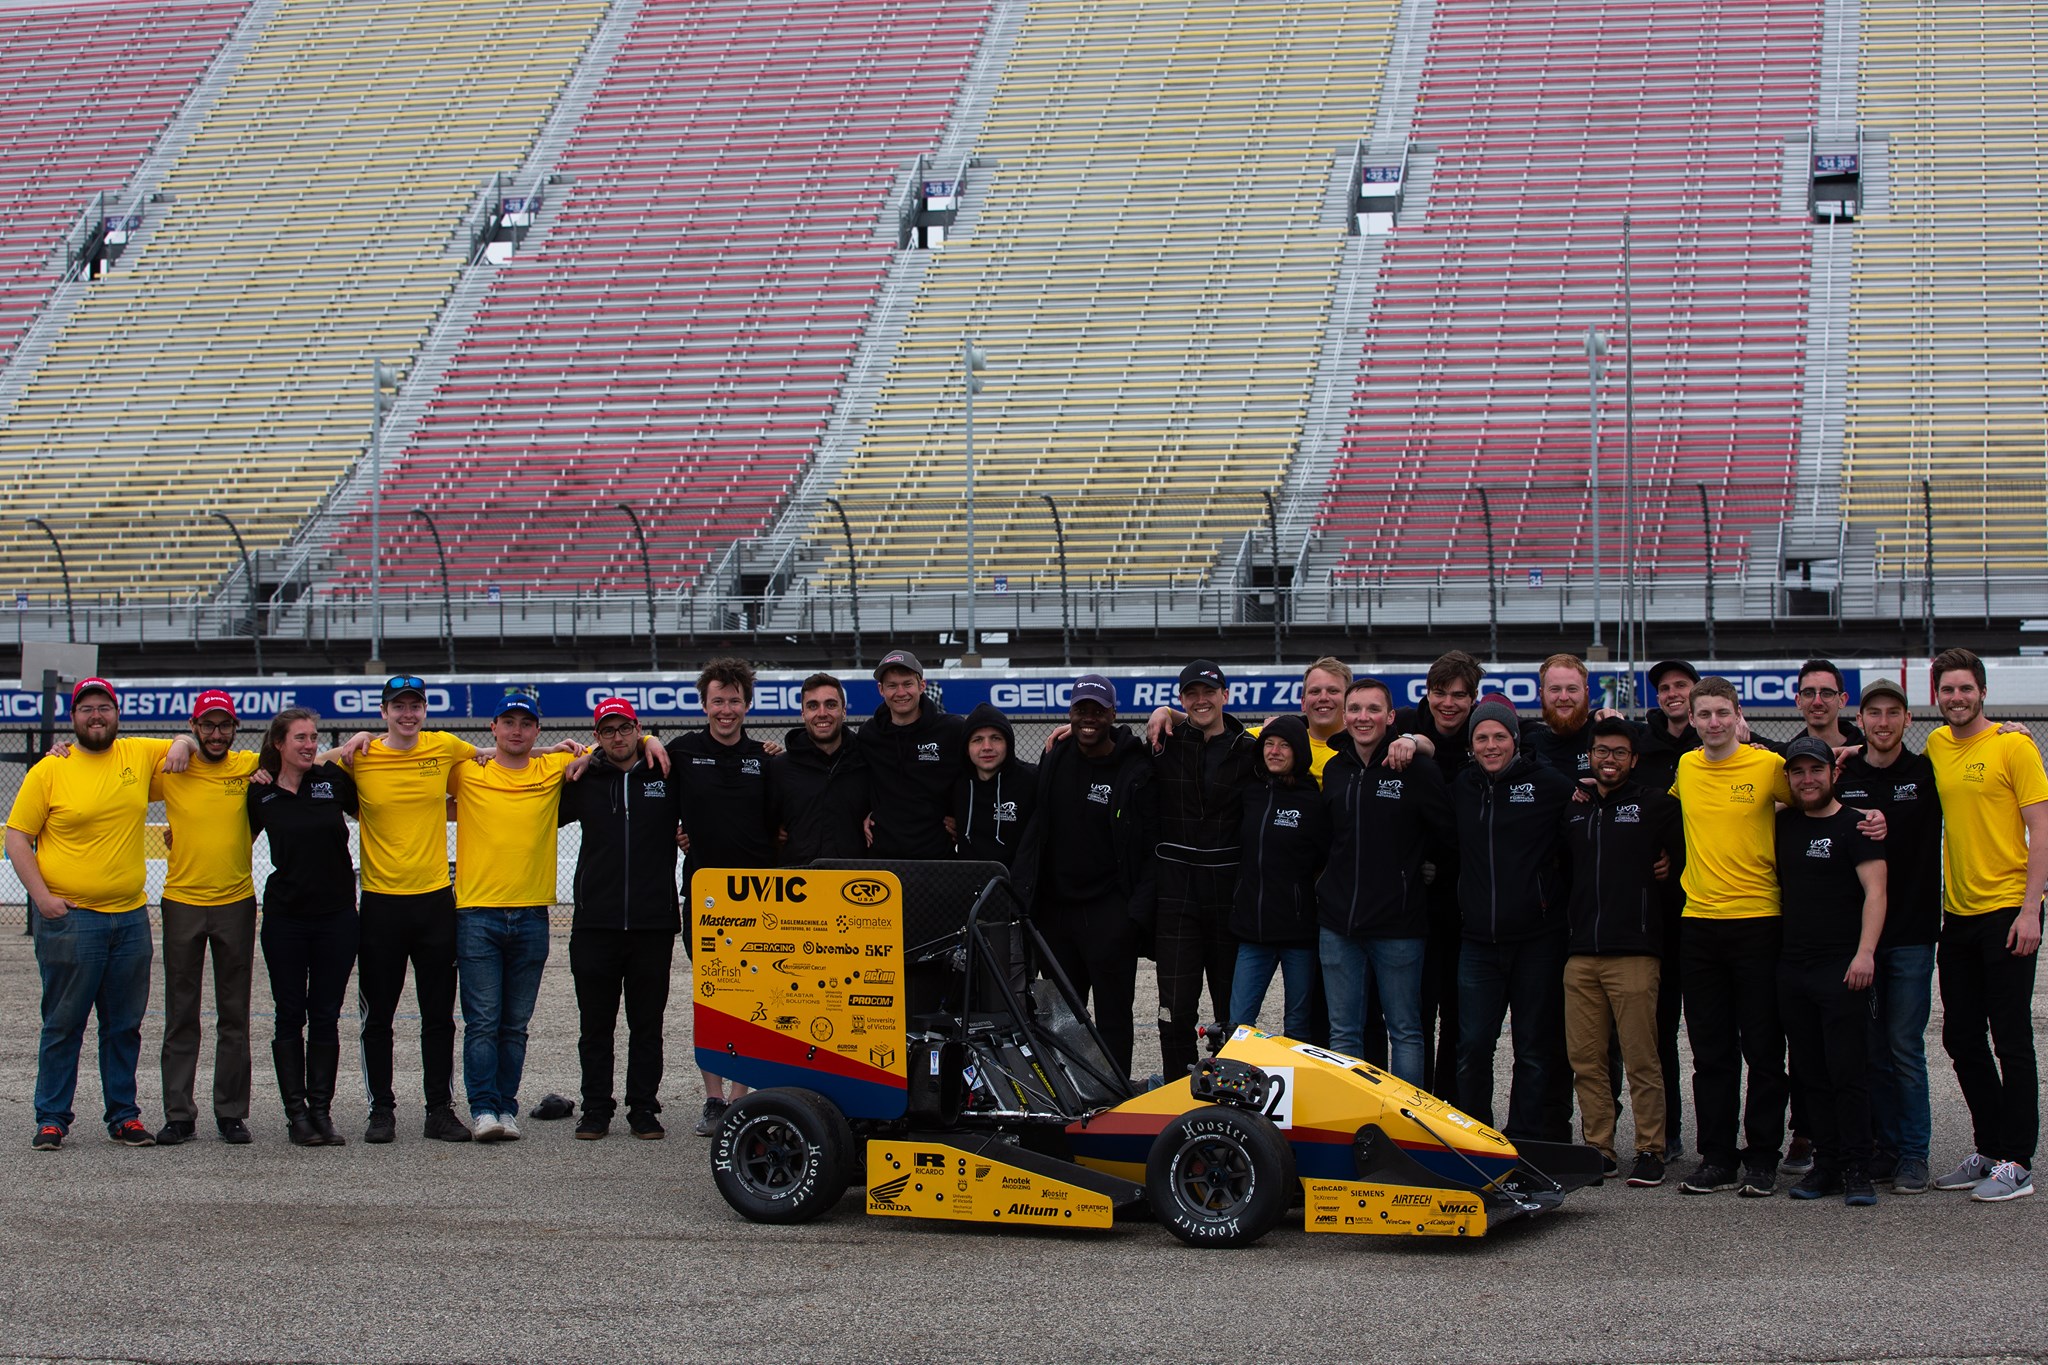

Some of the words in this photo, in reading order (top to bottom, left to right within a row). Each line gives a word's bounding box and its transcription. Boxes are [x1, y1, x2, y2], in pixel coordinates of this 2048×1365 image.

[1370, 171, 1382, 179] 32
[1385, 171, 1398, 179] 34
[930, 186, 941, 194] 30
[995, 583, 1006, 591] 32
[1529, 576, 1540, 586] 34
[1077, 682, 1107, 691] Champion
[1407, 678, 1537, 703] GCO
[333, 688, 451, 713] GEO
[990, 683, 1075, 708] GEIC
[728, 876, 808, 903] UVIC
[851, 884, 880, 897] CRP
[699, 914, 757, 927] Mastercam
[848, 915, 892, 928] sigmatex
[816, 942, 859, 955] brembo
[865, 945, 893, 957] SKF
[701, 964, 741, 976] StarFish
[865, 968, 895, 982] action
[852, 996, 890, 1005] PROCOM
[1265, 1074, 1285, 1121] 2
[1182, 1120, 1248, 1142] Hoosier
[715, 1109, 746, 1172] Hoosier
[792, 1142, 822, 1207] Hoosier
[1002, 1176, 1030, 1184] Anotek
[1041, 1189, 1068, 1198] Hoosier
[1501, 1183, 1519, 1191] CRP
[1392, 1194, 1432, 1204] AIRTECH
[870, 1203, 912, 1212] HONDA
[1008, 1203, 1058, 1216] Altium
[1439, 1205, 1478, 1213] VMAC
[1174, 1216, 1240, 1237] Hoosier
